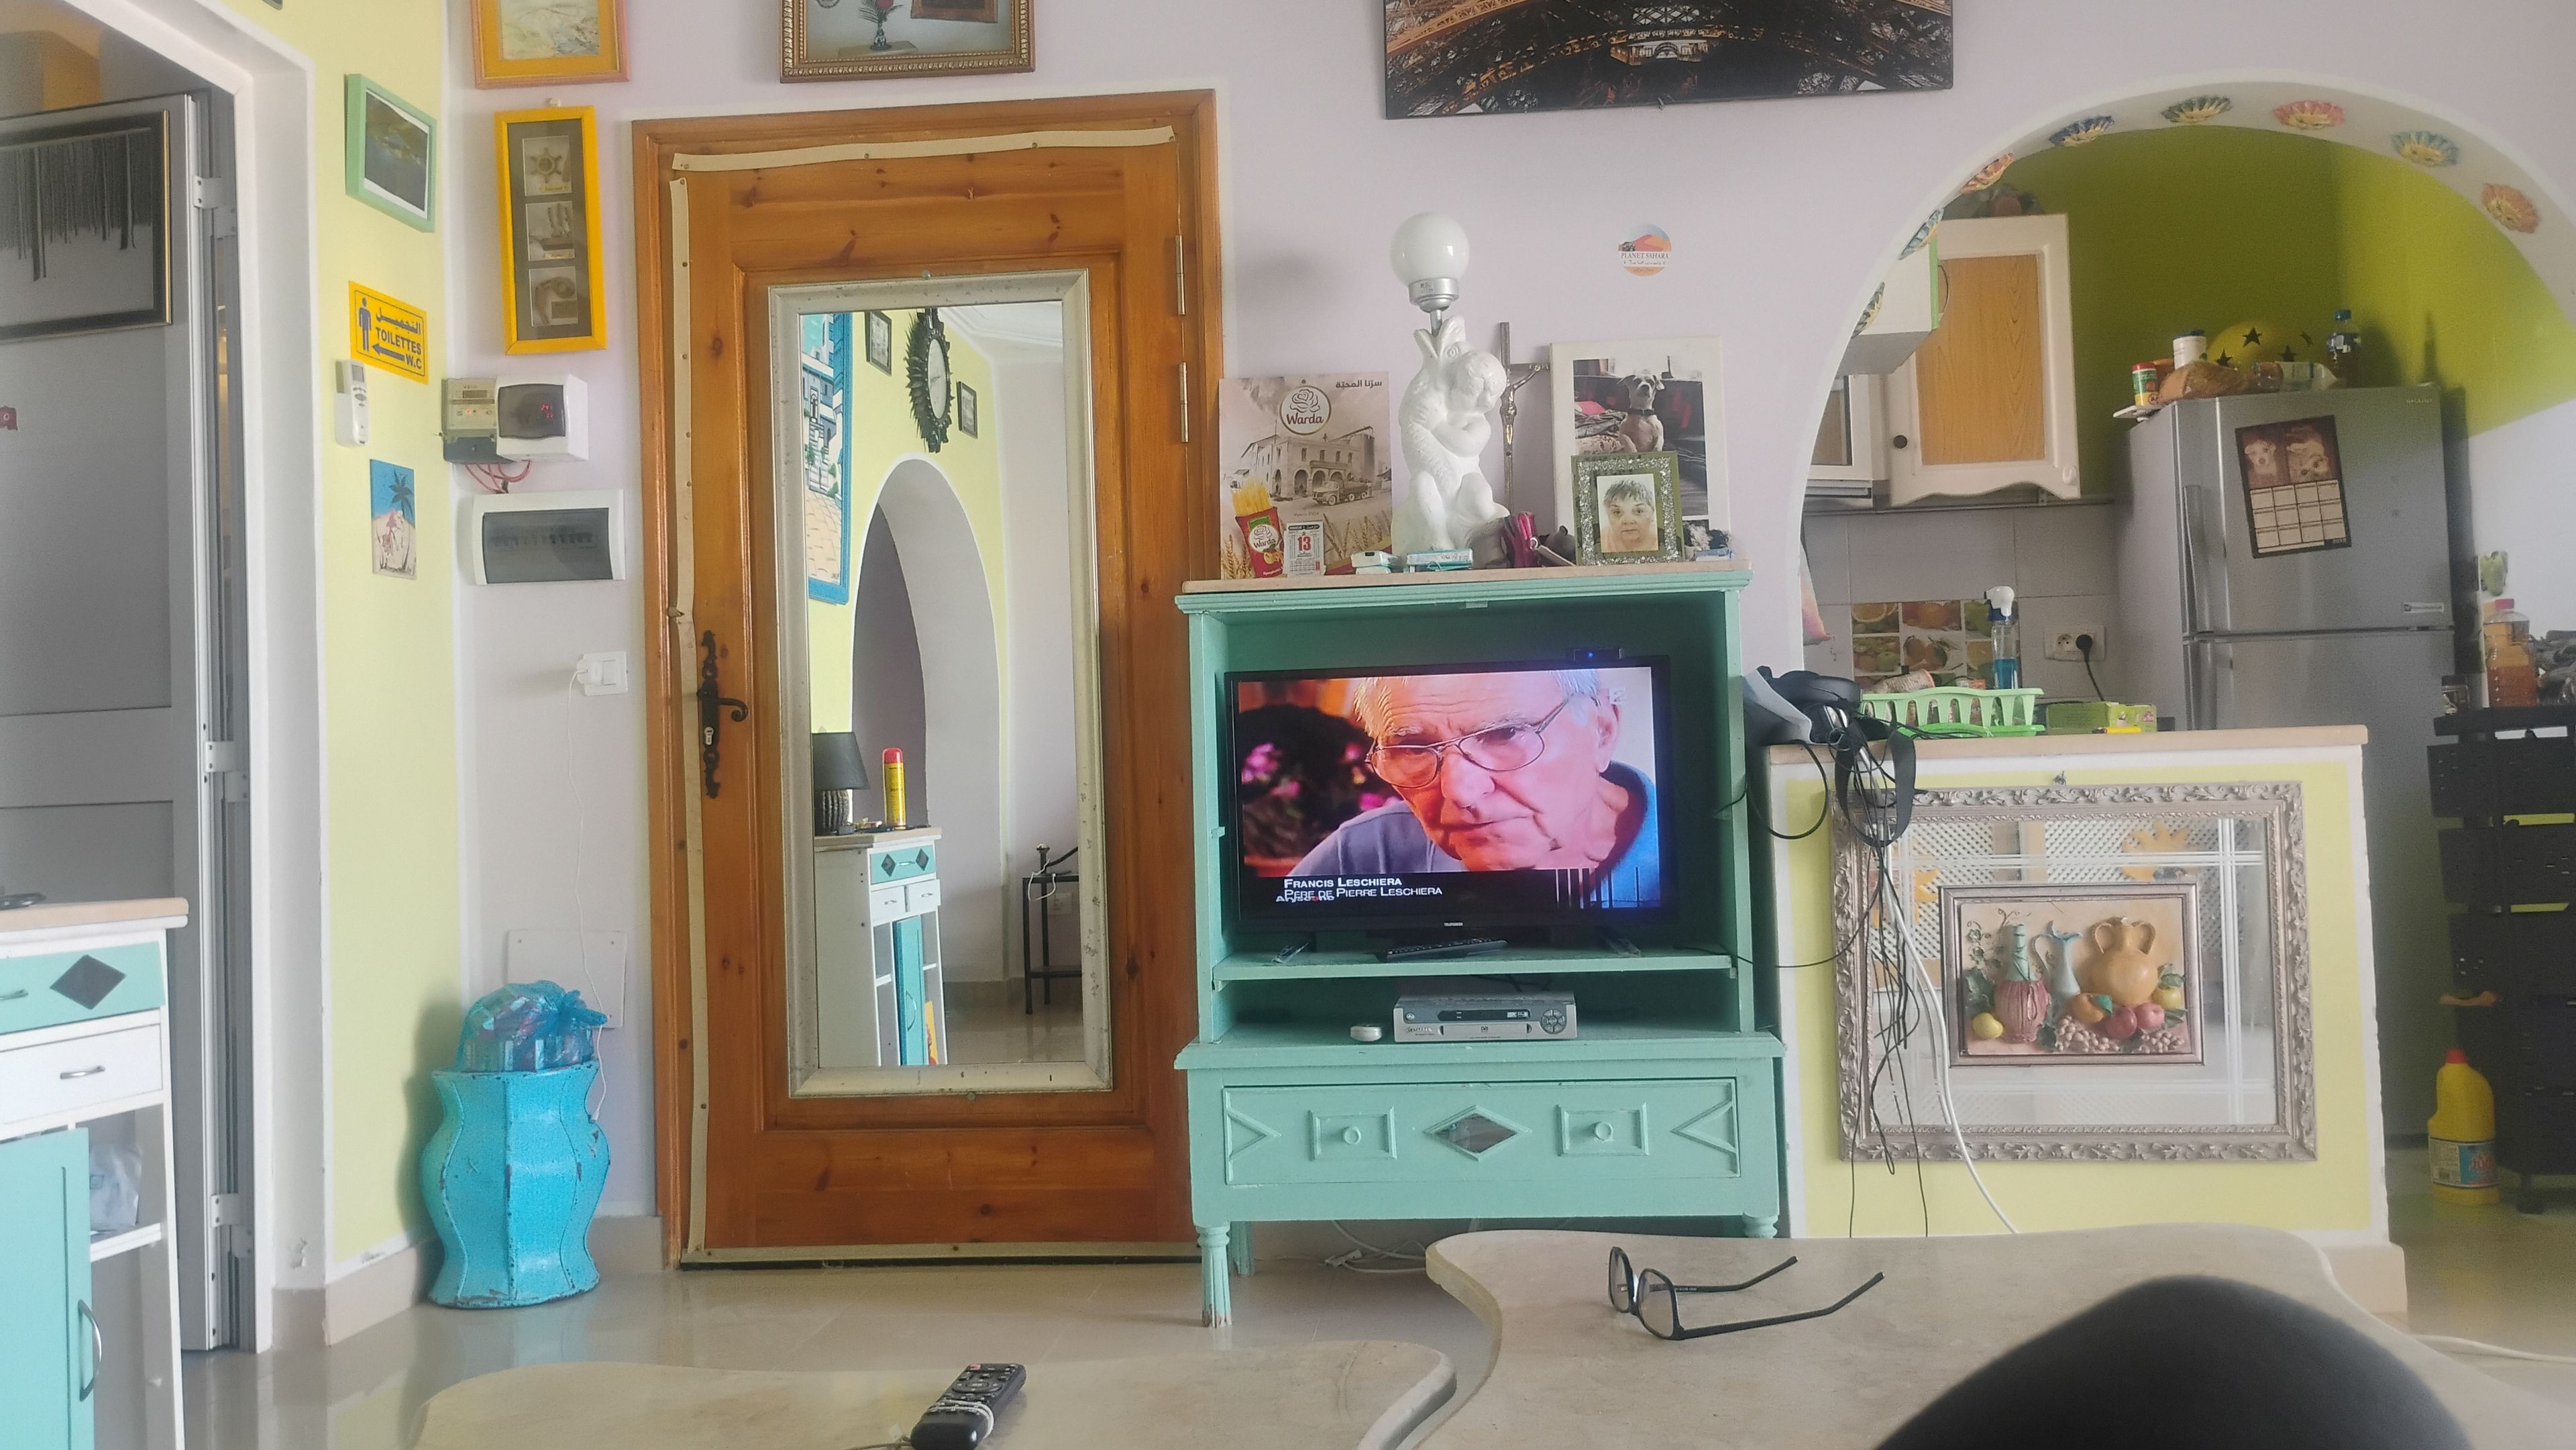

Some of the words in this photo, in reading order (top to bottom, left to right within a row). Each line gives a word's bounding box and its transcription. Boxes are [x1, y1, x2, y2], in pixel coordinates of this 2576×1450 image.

[376, 327, 421, 355] TOILETTES
[405, 354, 422, 370] W.C
[1287, 412, 1324, 425] Warda
[1253, 538, 1276, 548] Warda
[1297, 536, 1311, 551] 13
[1284, 878, 1334, 888] FRANCIS
[1338, 877, 1402, 887] LESCHIERA
[1336, 887, 1377, 898] PIERRE
[1380, 886, 1443, 896] LESCHIERA
